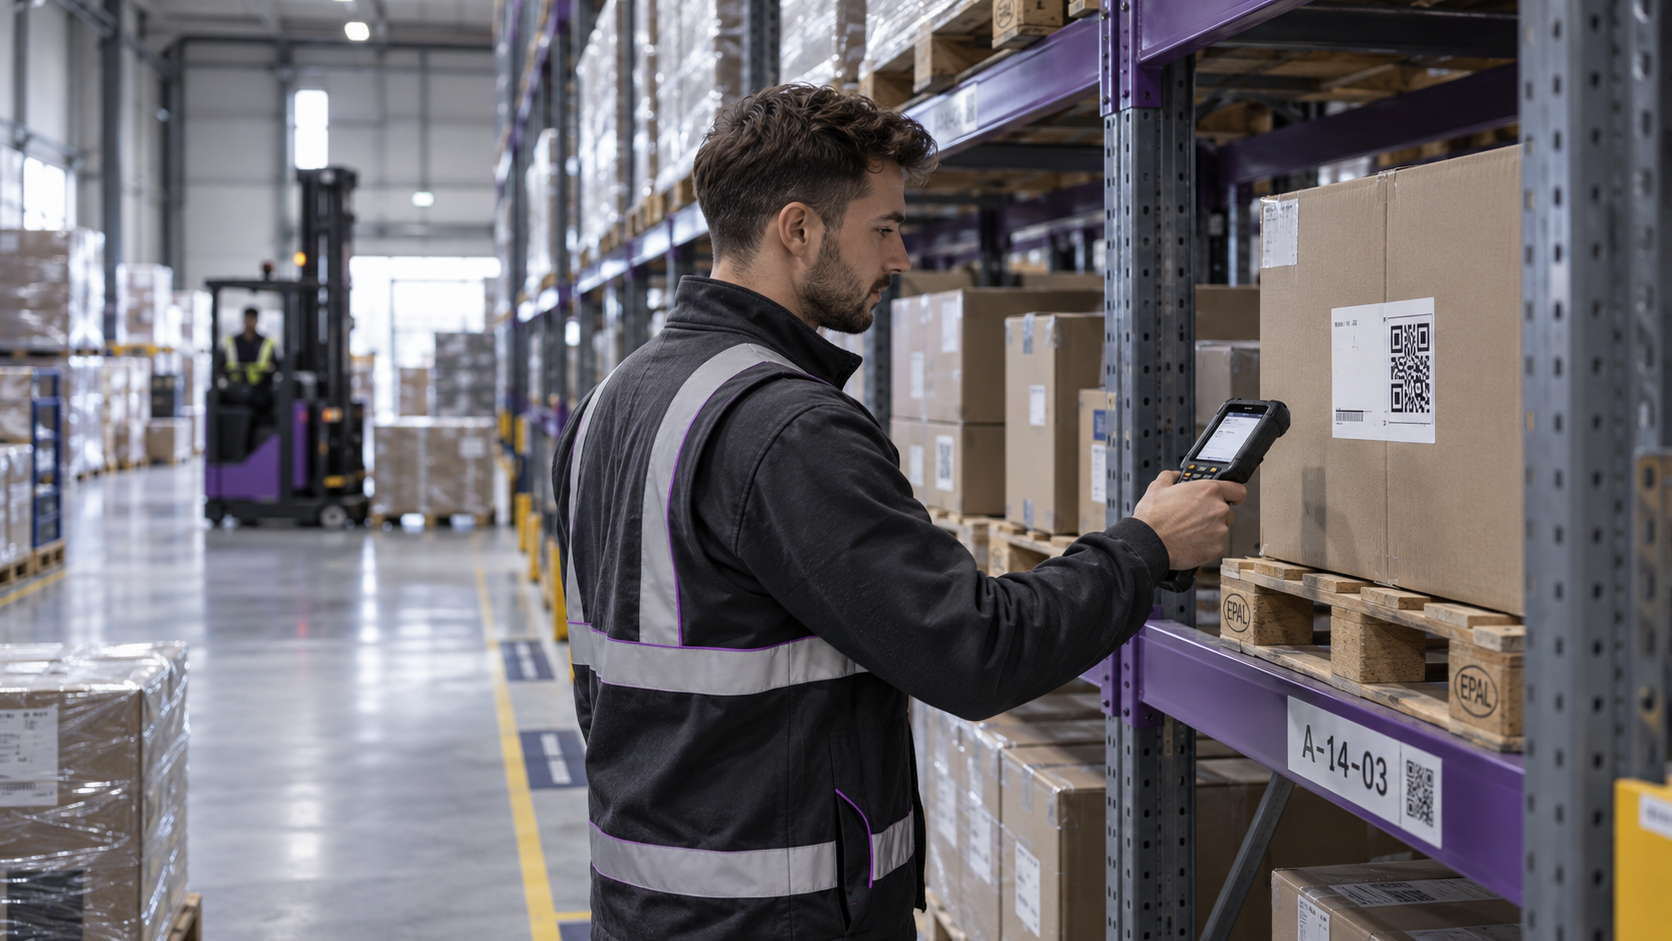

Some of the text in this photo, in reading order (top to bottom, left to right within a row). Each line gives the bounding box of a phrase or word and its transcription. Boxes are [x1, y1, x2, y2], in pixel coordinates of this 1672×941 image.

[1227, 600, 1247, 625] EPAL
[1461, 673, 1492, 708] EPAL
[1302, 724, 1388, 797] A-14-03
